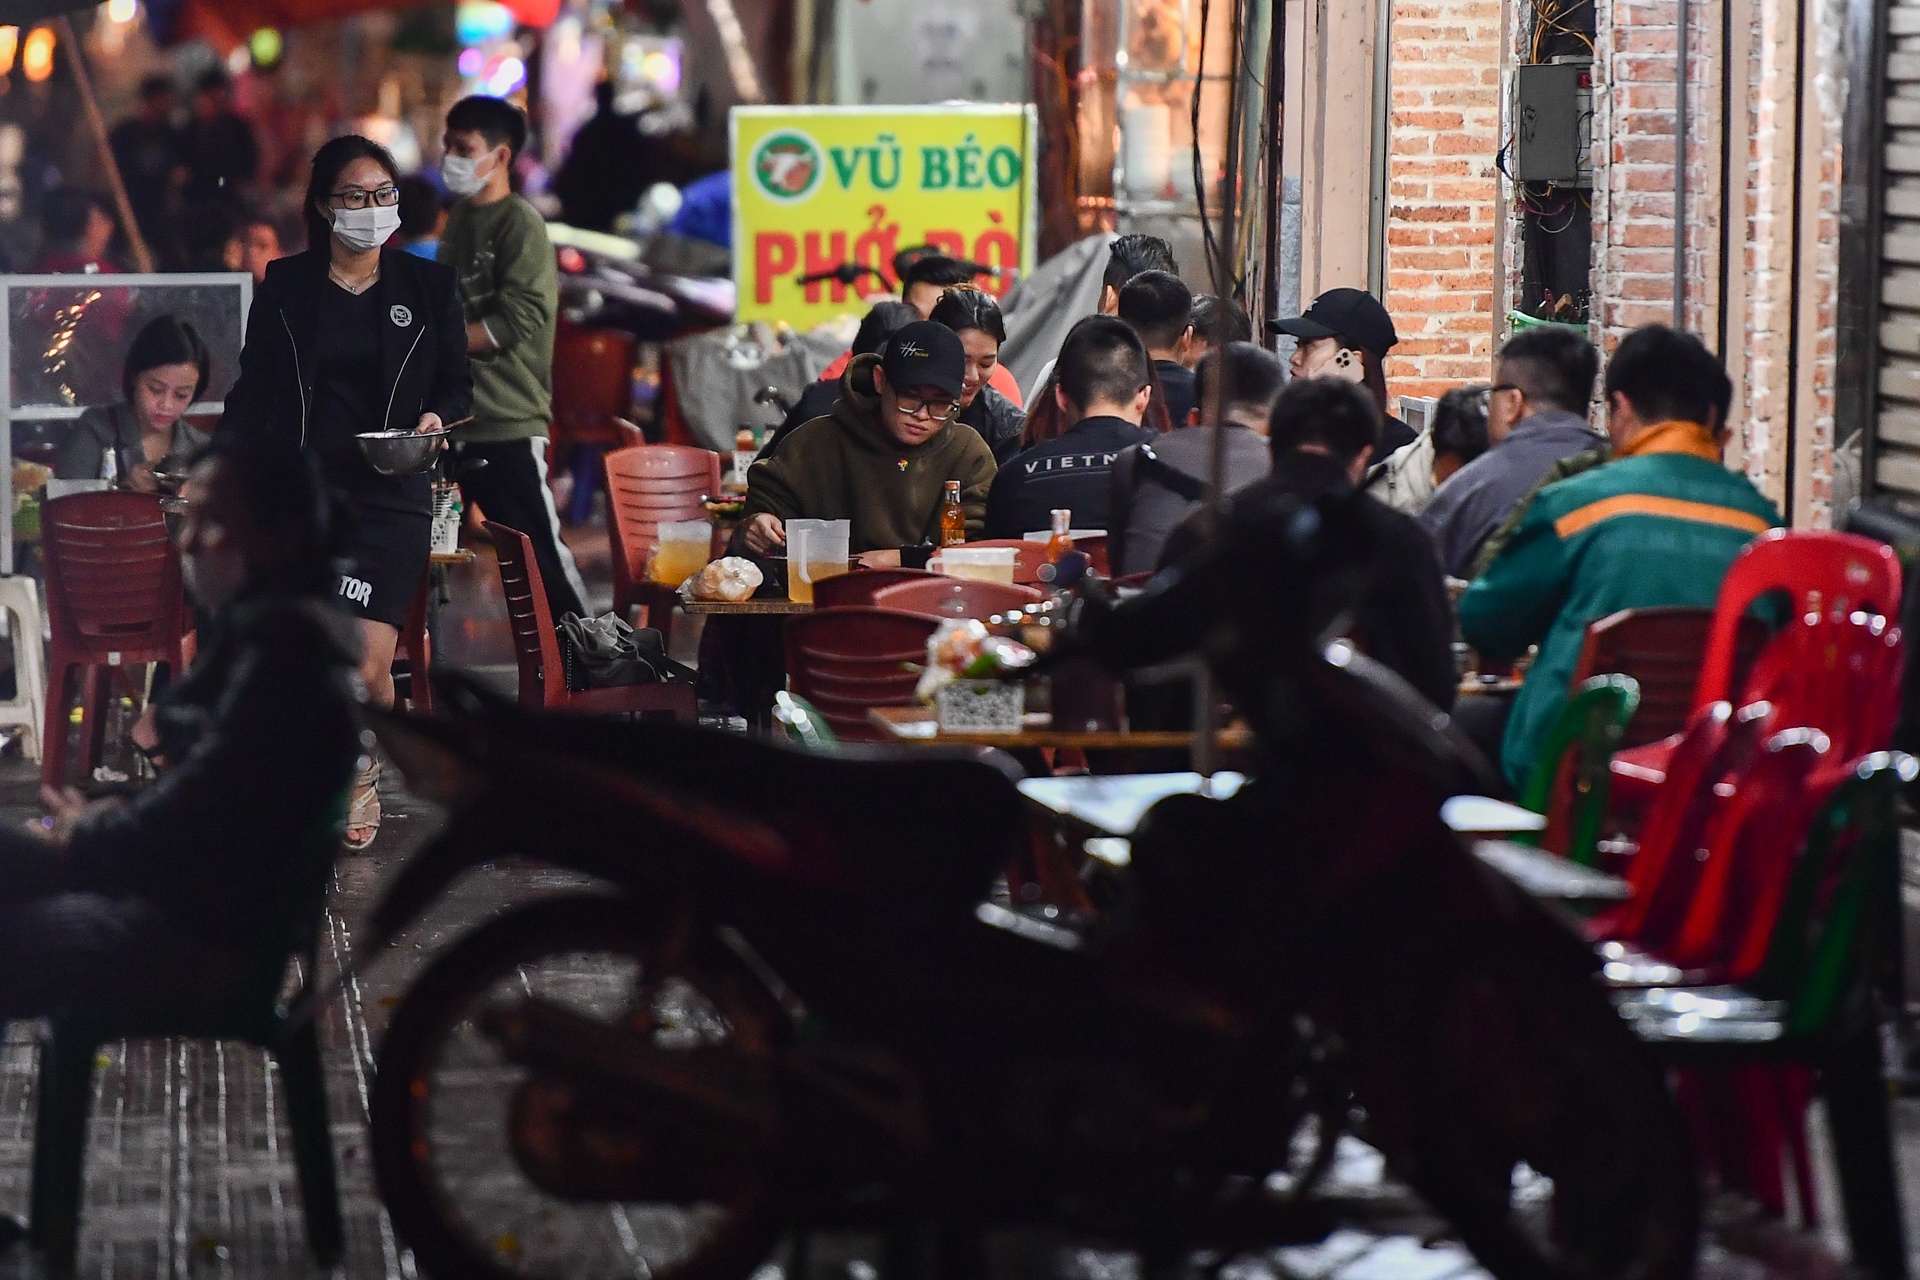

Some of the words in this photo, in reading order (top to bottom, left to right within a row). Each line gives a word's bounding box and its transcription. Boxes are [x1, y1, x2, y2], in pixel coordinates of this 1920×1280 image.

[829, 133, 903, 190] VŨ
[920, 132, 1022, 190] BÉO
[755, 204, 900, 304] PHỞ
